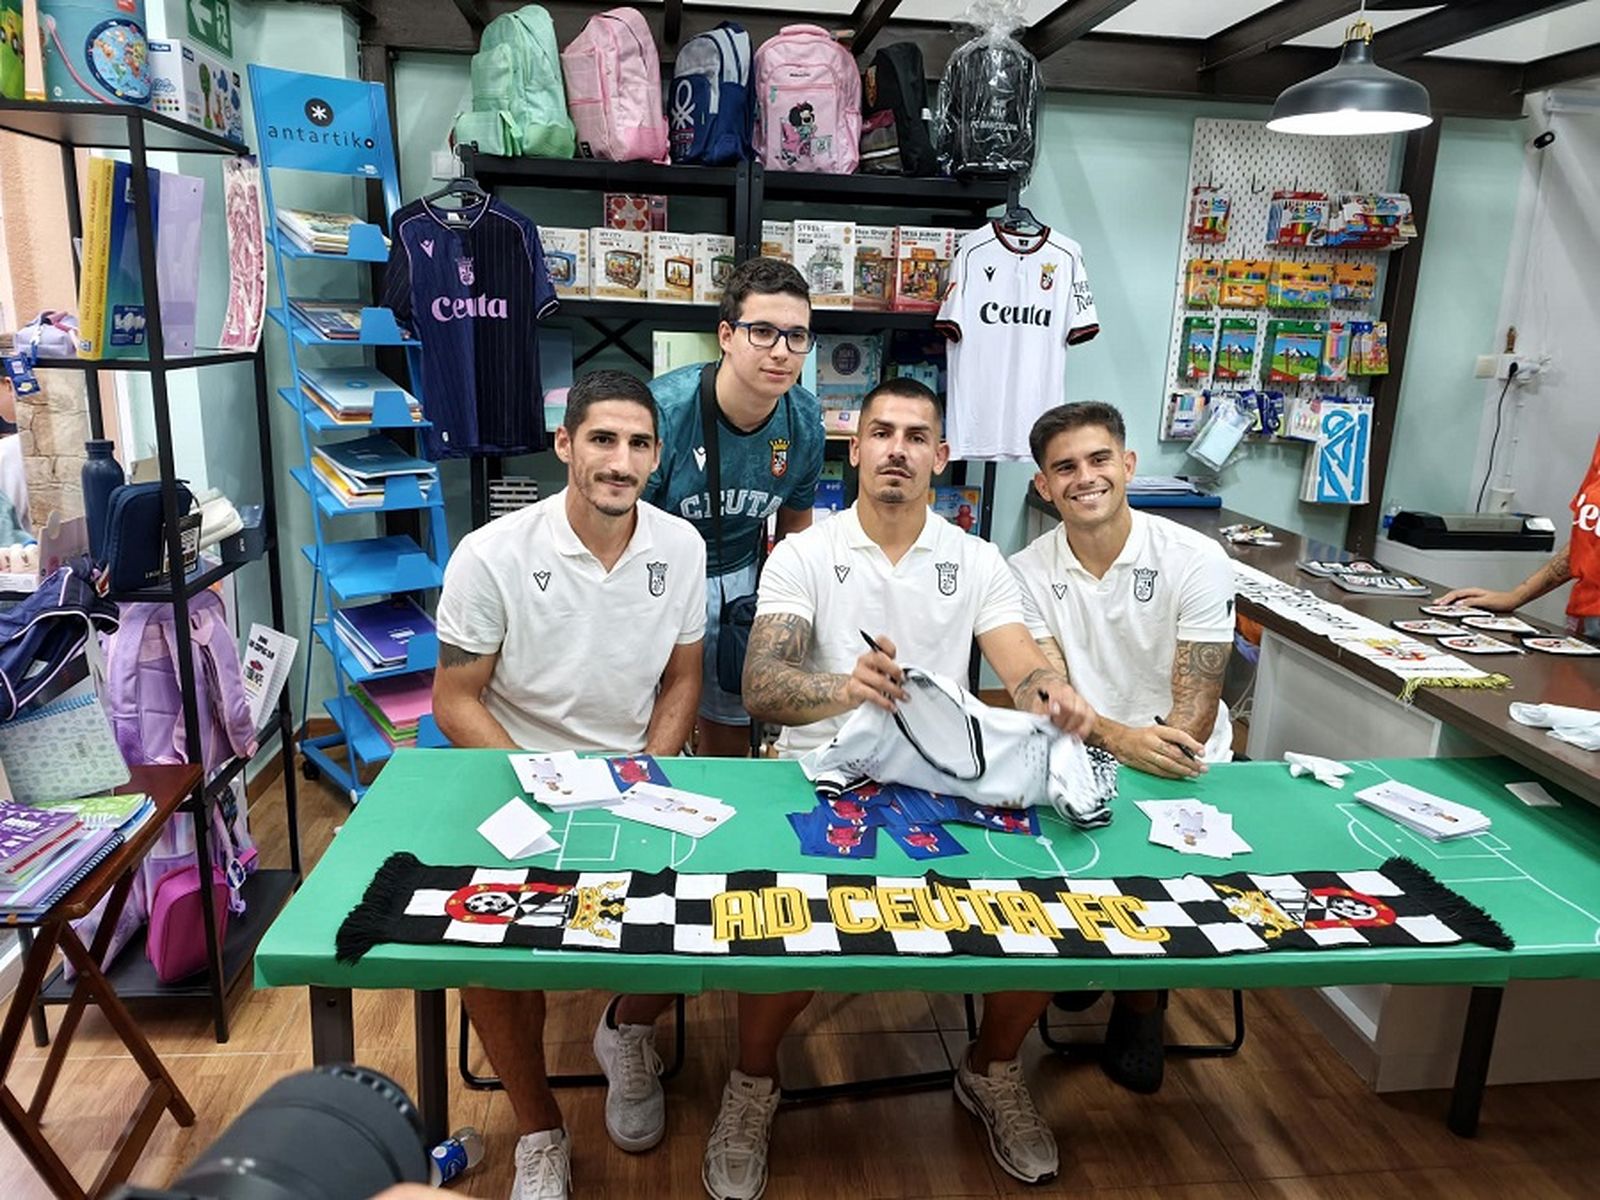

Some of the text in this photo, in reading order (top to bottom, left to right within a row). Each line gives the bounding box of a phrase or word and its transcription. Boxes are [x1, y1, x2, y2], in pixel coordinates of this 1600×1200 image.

[267, 125, 375, 149] antartiko
[431, 293, 508, 322] Ceuta
[979, 301, 1052, 327] Ceuta
[711, 882, 1171, 944] AD CEUTA FC
